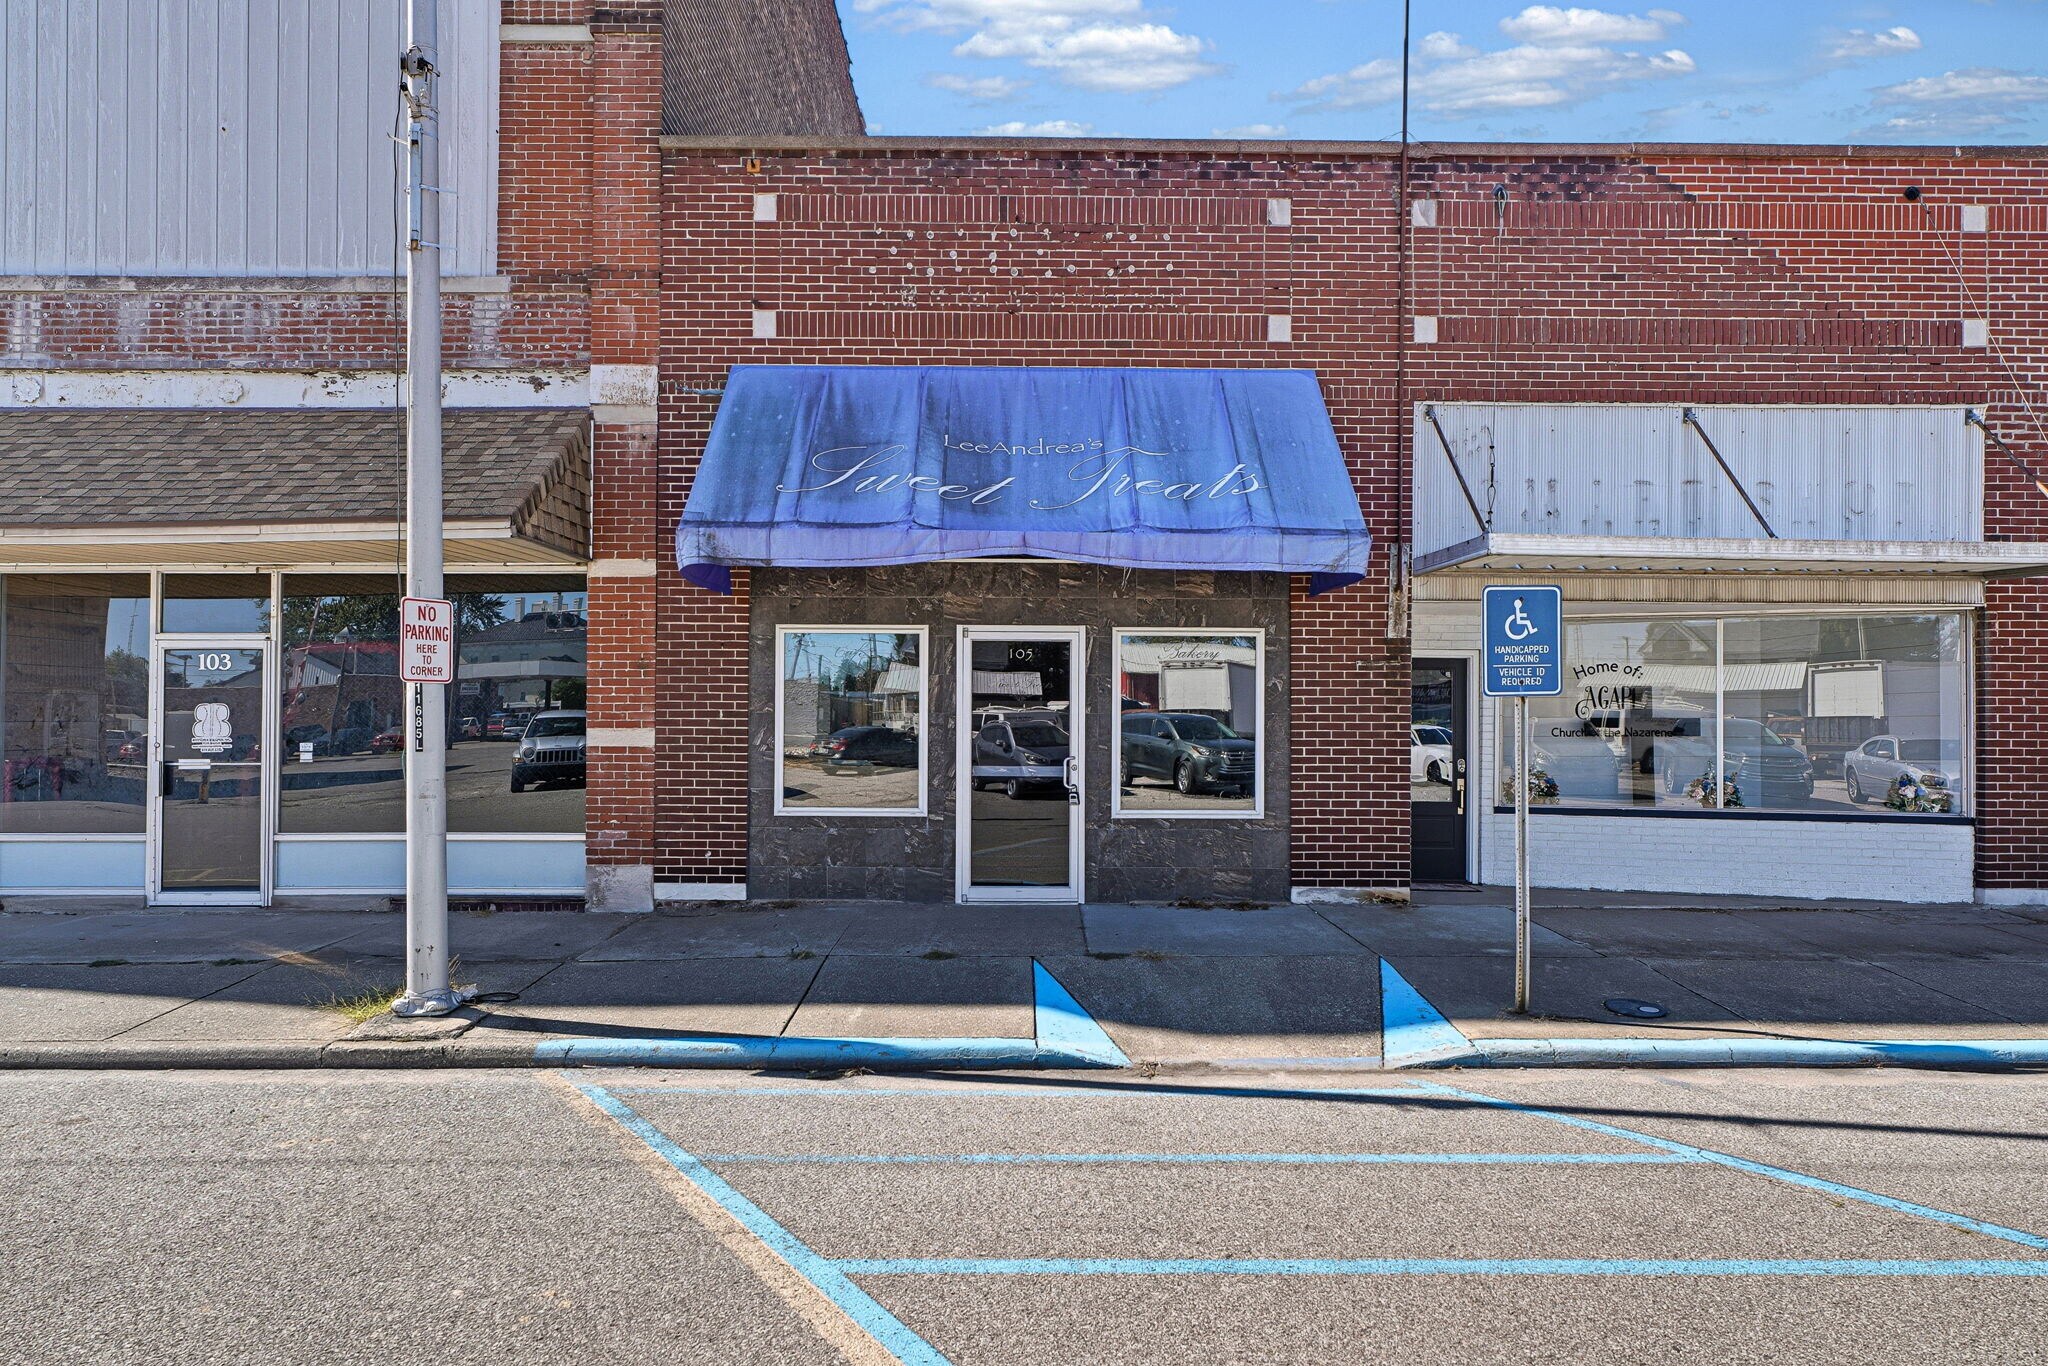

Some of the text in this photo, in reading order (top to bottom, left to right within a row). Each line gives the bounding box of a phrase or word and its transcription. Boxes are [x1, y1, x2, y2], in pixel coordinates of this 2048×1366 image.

[944, 434, 1103, 455] LeeAndrea's
[776, 444, 1268, 510] Sweet Treats
[417, 605, 437, 622] NO
[405, 623, 449, 642] PARKING
[416, 643, 438, 654] HERE
[1009, 648, 1033, 662] 105
[1157, 640, 1221, 662] Bakery
[1494, 645, 1550, 654] HANDICAPPED
[198, 653, 232, 671] 103
[422, 655, 432, 665] TO
[1504, 654, 1540, 663] PARKING
[410, 665, 443, 677] CORNER
[1499, 667, 1546, 677] VEHICLE ID
[1573, 662, 1644, 680] Home of:
[415, 683, 423, 750] 11685L
